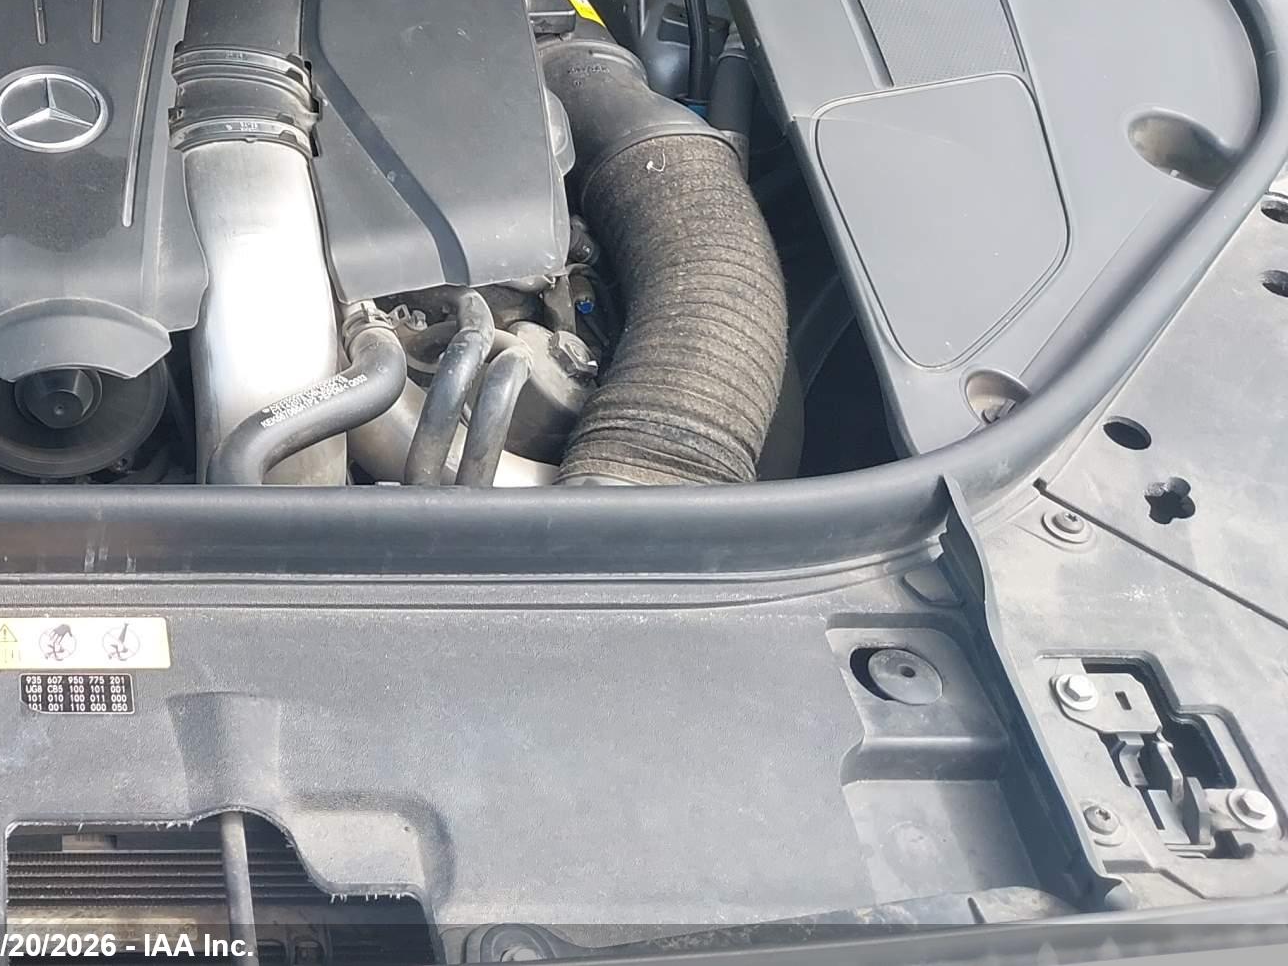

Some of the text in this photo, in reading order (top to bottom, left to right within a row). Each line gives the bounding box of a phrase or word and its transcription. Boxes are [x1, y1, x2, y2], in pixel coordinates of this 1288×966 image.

[25, 675, 125, 685] 935 607 950 775 201
[70, 685, 85, 694] 100
[90, 685, 105, 694] 101
[110, 685, 125, 694] 001
[28, 694, 127, 703] 101 010 100 011 000
[28, 703, 128, 712] 101 001 110 000 050
